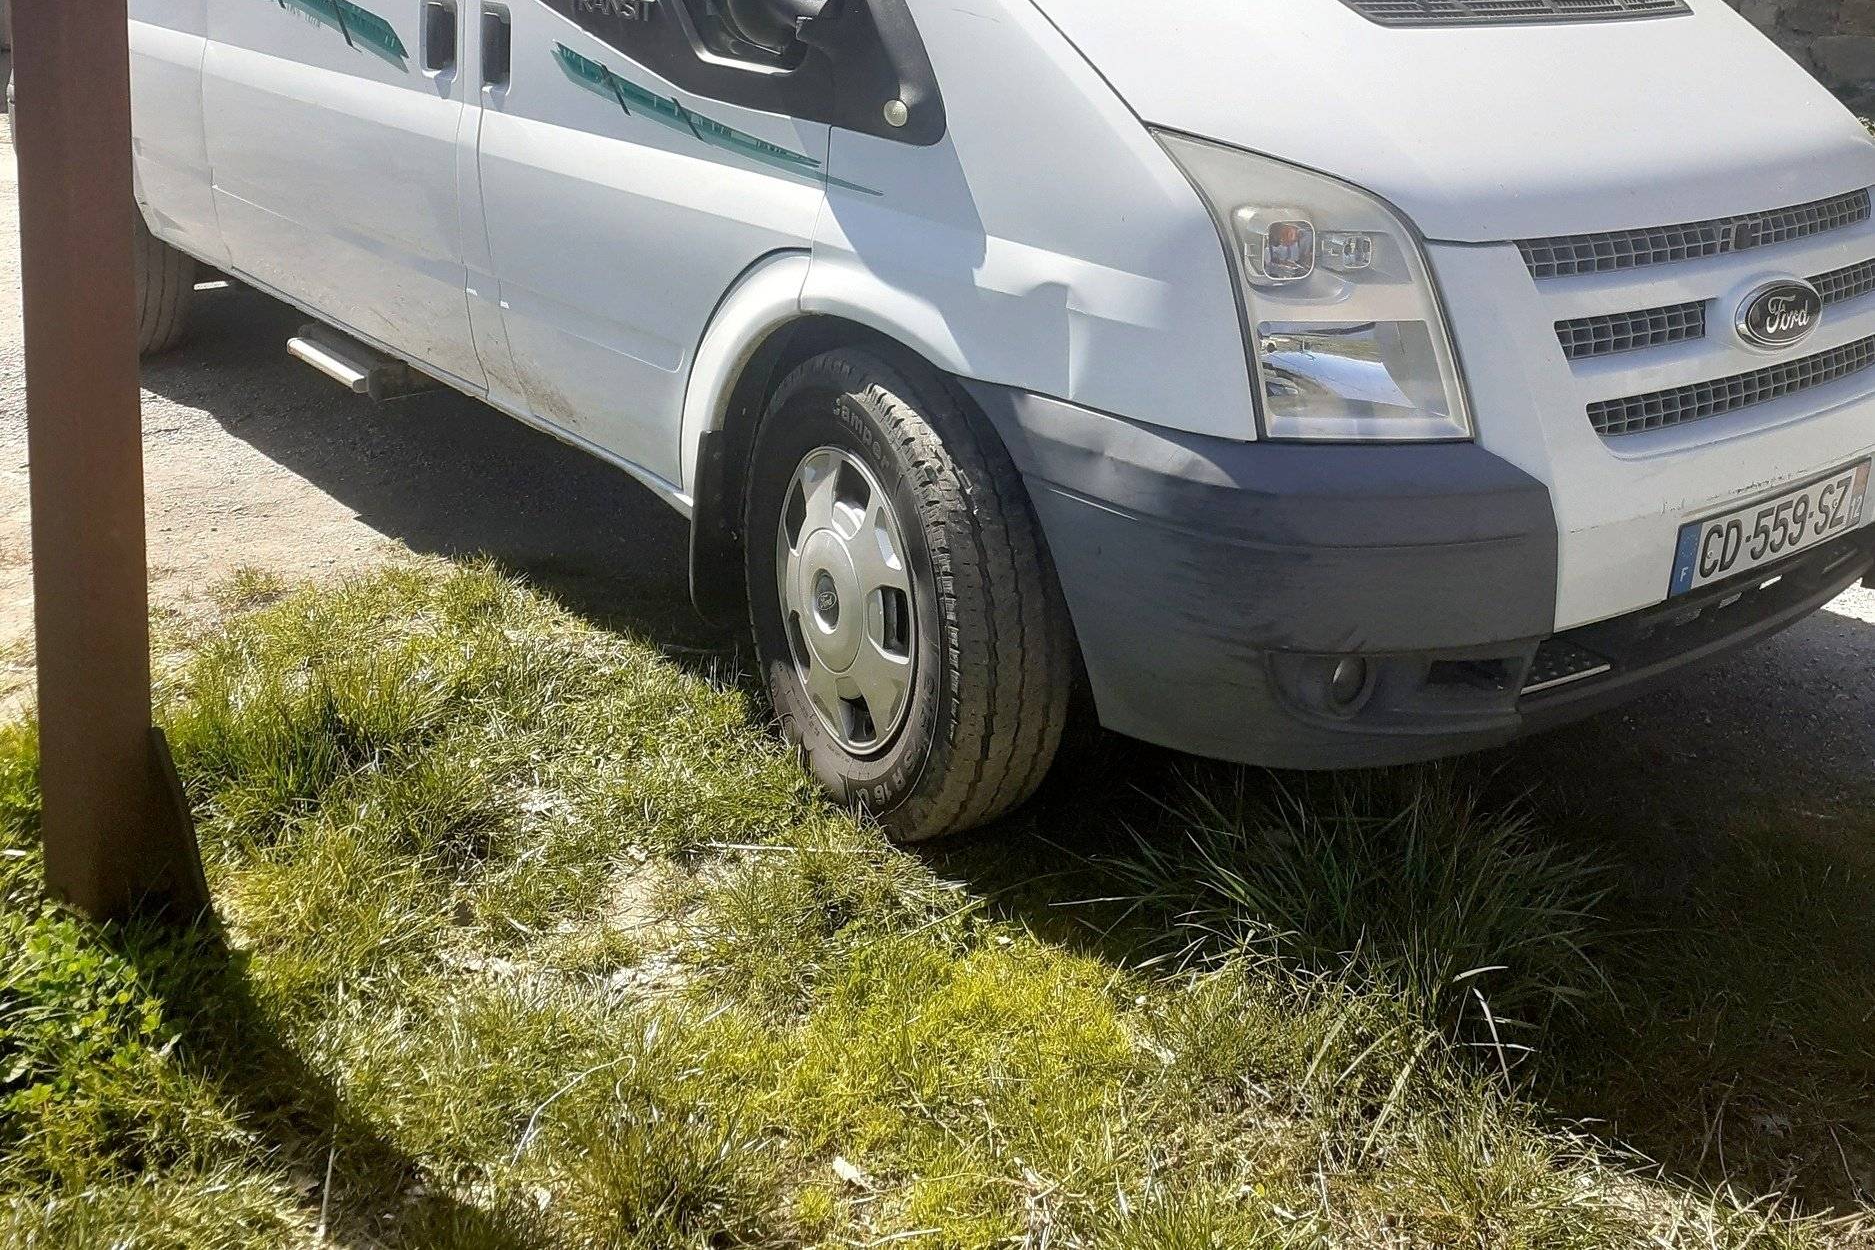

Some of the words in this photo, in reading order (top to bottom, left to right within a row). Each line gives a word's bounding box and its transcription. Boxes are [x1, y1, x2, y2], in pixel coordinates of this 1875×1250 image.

[1766, 293, 1811, 334] Ford
[1679, 566, 1690, 582] F
[1700, 476, 1853, 579] CD-559-SZ
